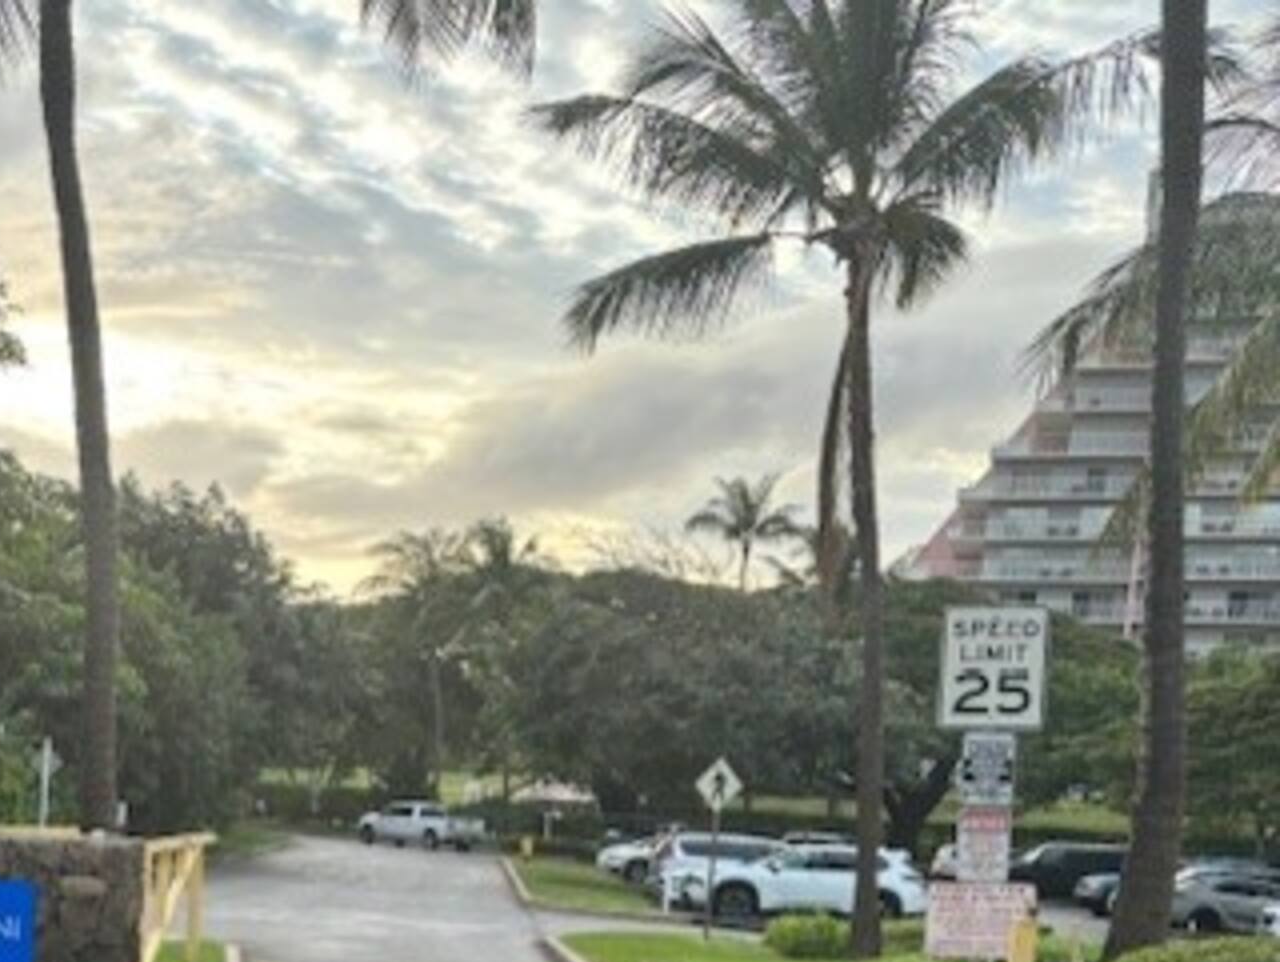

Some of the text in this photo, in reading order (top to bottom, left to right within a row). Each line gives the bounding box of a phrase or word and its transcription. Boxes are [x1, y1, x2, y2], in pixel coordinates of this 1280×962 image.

[953, 618, 1041, 638] SPEED
[960, 643, 1027, 662] LIMIT
[953, 667, 1031, 714] 25
